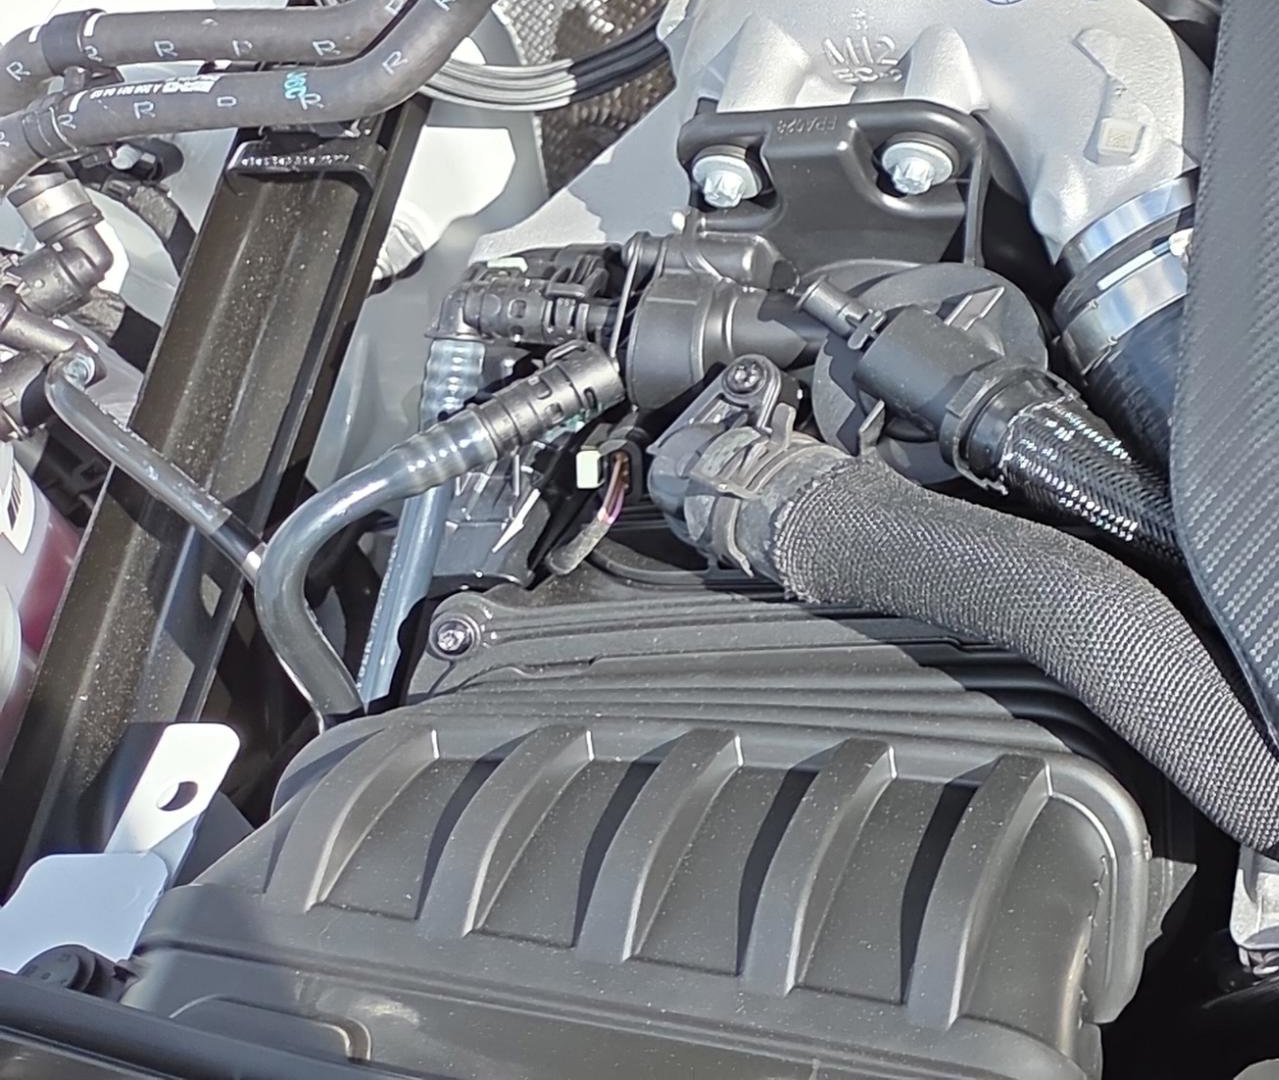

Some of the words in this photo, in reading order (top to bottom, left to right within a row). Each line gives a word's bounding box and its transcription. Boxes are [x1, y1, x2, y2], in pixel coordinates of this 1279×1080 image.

[154, 40, 179, 57] R
[313, 40, 341, 56] R
[133, 101, 156, 120] R
[382, 50, 408, 75] R
